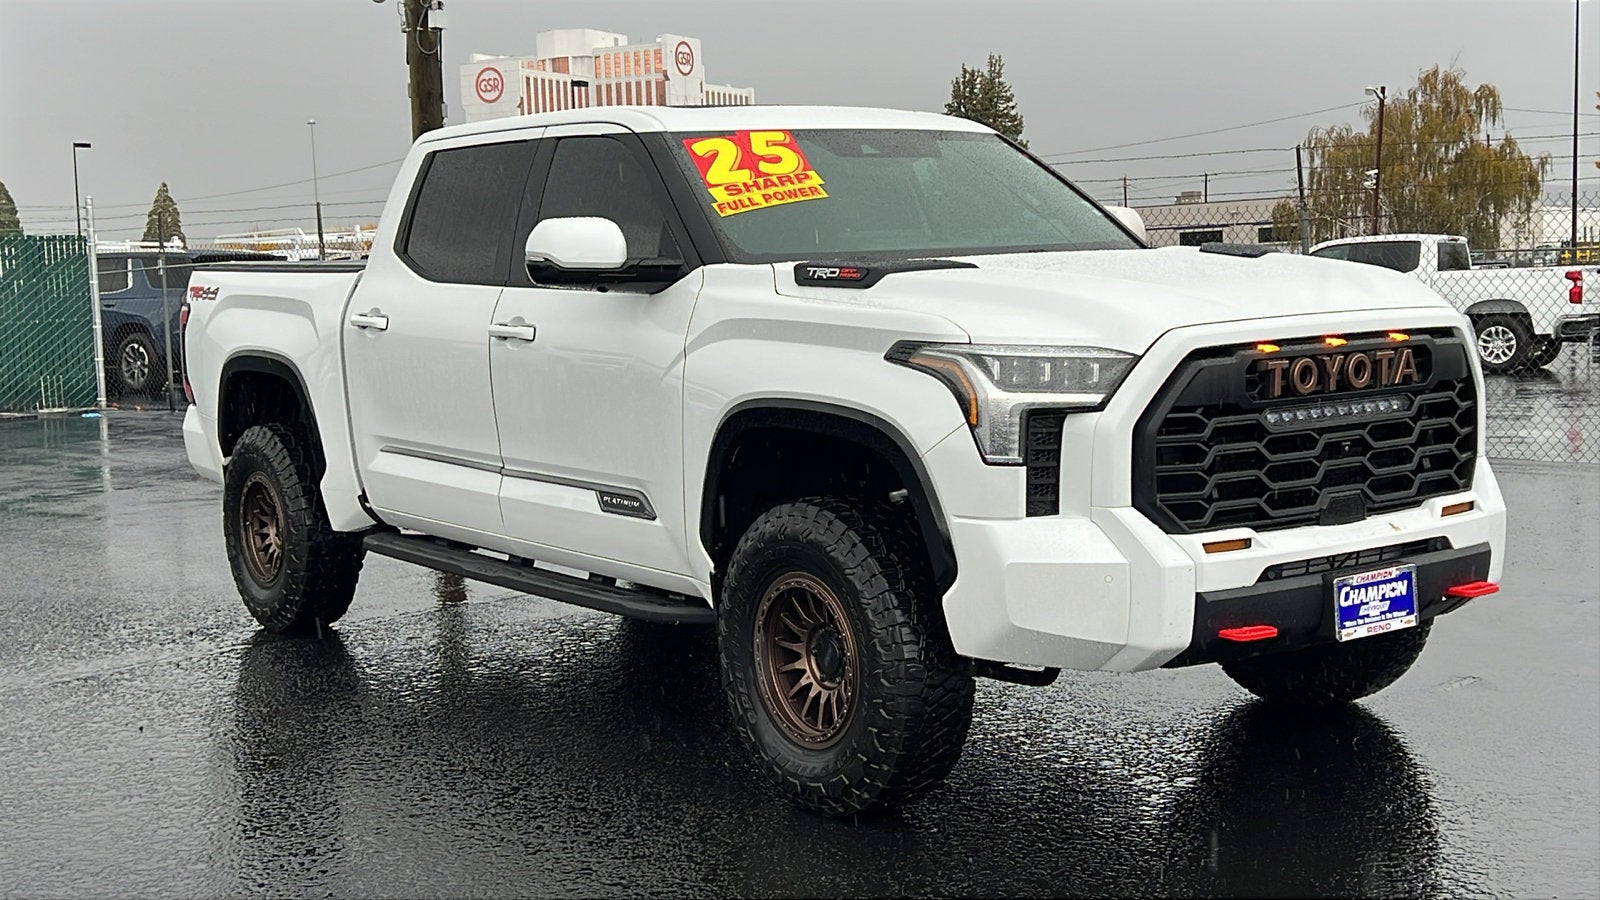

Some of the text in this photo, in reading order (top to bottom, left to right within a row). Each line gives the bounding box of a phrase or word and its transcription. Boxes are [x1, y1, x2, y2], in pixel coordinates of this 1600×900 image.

[676, 51, 693, 67] GSR
[478, 78, 500, 93] GSR
[691, 131, 804, 185] 25
[724, 172, 813, 197] SHARP
[716, 186, 822, 214] FULL POWER
[806, 267, 840, 279] TRD
[1266, 349, 1419, 397] TOYOTA
[603, 496, 640, 507] PLATINUM
[1356, 570, 1393, 584] CHAMPION
[1340, 580, 1408, 607] CHAMPION
[1366, 623, 1392, 634] RENO
